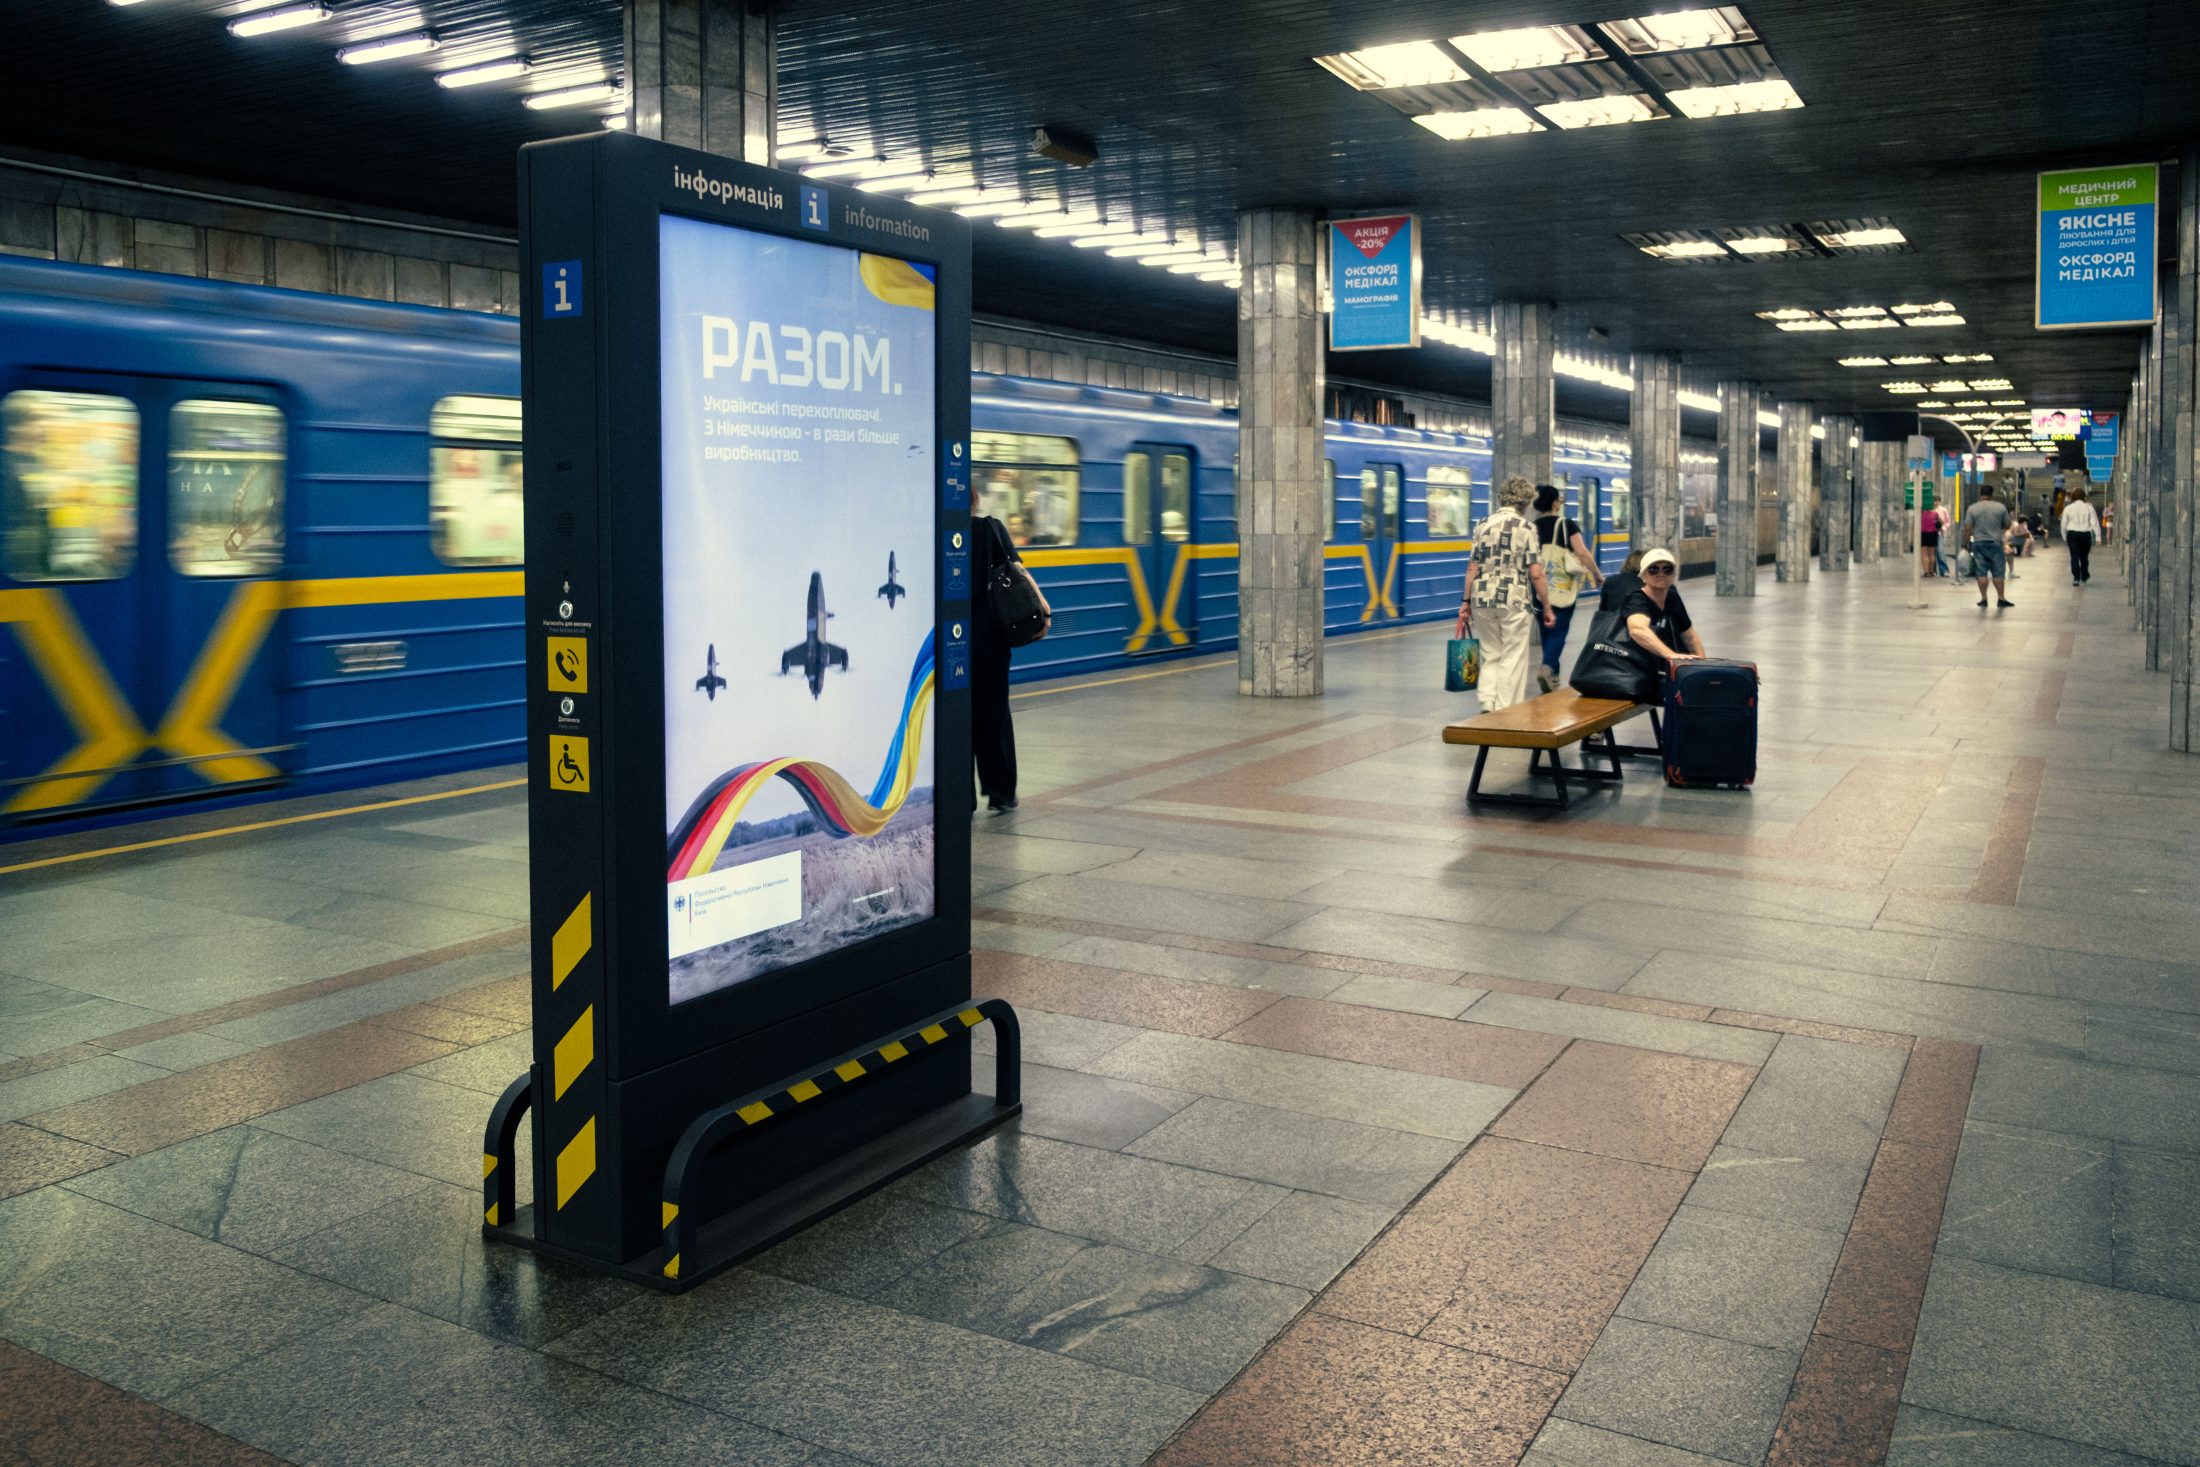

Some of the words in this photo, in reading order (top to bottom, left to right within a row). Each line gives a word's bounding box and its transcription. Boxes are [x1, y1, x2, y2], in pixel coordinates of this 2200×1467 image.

[2058, 178, 2137, 195] МЕДИЧНИЙ
[674, 166, 783, 210] інформація
[845, 205, 930, 242] information
[2075, 194, 2119, 206] ЦЕНТР
[2058, 212, 2136, 231] ЯКІСНЕ
[1354, 226, 1389, 239] АКЦІЯ
[2058, 229, 2114, 240] ЛІКУВАННЯ
[2115, 227, 2136, 237] ДЛЯ
[2058, 239, 2105, 249] ДОРОСЛИХ
[2111, 236, 2136, 246] ДІТЕЙ
[2058, 251, 2136, 268] ОКСФОРД
[1344, 264, 1398, 278] ОКСФОРД
[2059, 266, 2135, 282] МЕДІКАЛ
[1345, 276, 1398, 288] МЕДІКАЛ
[1344, 294, 1398, 305] МАМОГРАФІЯ
[702, 314, 903, 396] РАЗОМ.
[703, 395, 779, 415] Українські
[782, 403, 882, 423] перехоплювачі.
[704, 420, 714, 435] З
[717, 420, 802, 440] Німеччиною
[813, 429, 822, 441] в
[824, 430, 855, 443] рази
[857, 429, 900, 444] більше
[705, 446, 802, 465] виробництво.
[1593, 643, 1629, 656] INTERTOP
[694, 885, 727, 898] Посольство
